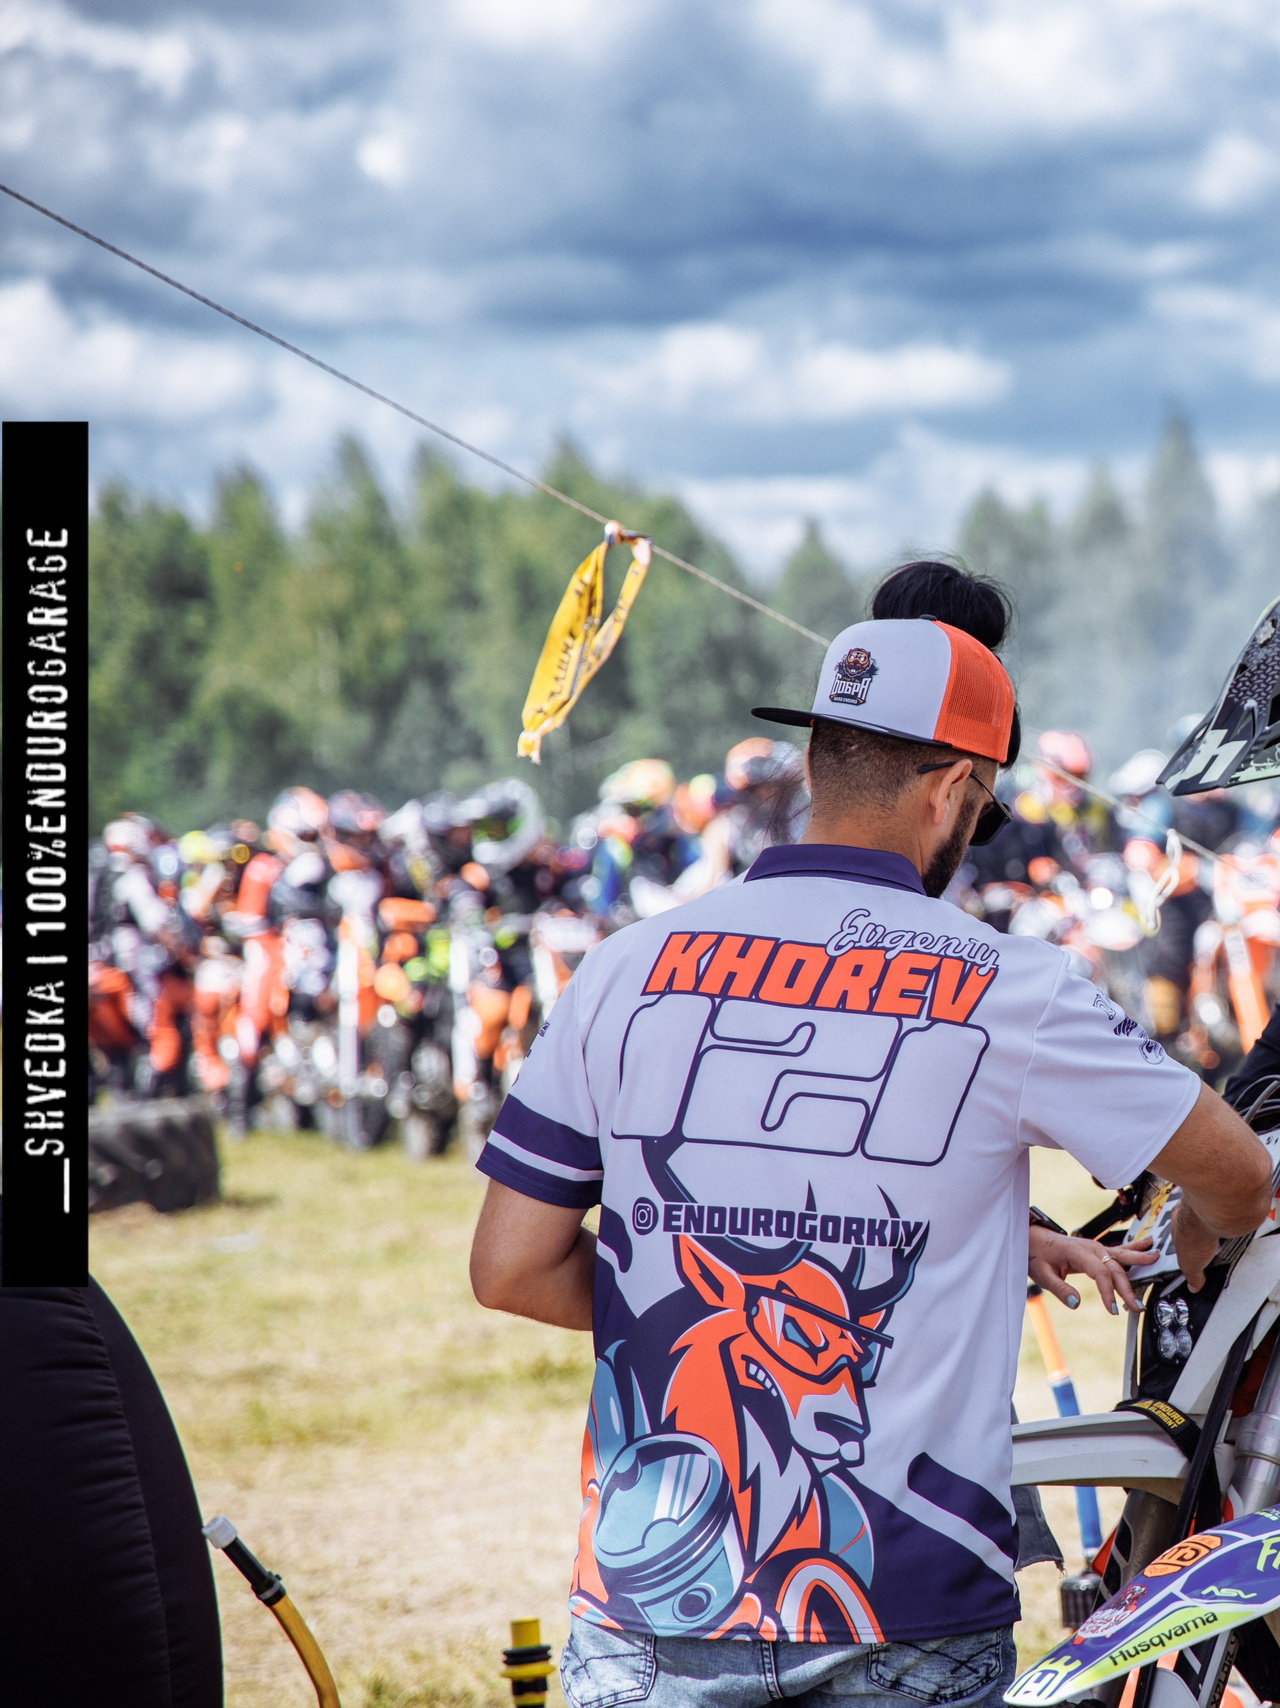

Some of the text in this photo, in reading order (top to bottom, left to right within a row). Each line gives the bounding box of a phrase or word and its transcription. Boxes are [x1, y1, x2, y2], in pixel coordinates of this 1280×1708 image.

[831, 673, 872, 701] БОБРА
[826, 908, 999, 975] Evgeniy
[641, 931, 999, 1024] KHOREV
[611, 994, 991, 1166] 121
[662, 1203, 924, 1248] ENDUROGORKIY
[1148, 1406, 1178, 1429] ELEMENT
[1152, 1401, 1186, 1425] ENDURO
[1201, 1585, 1258, 1599] ASV
[1109, 1611, 1219, 1666] Husqvarna
